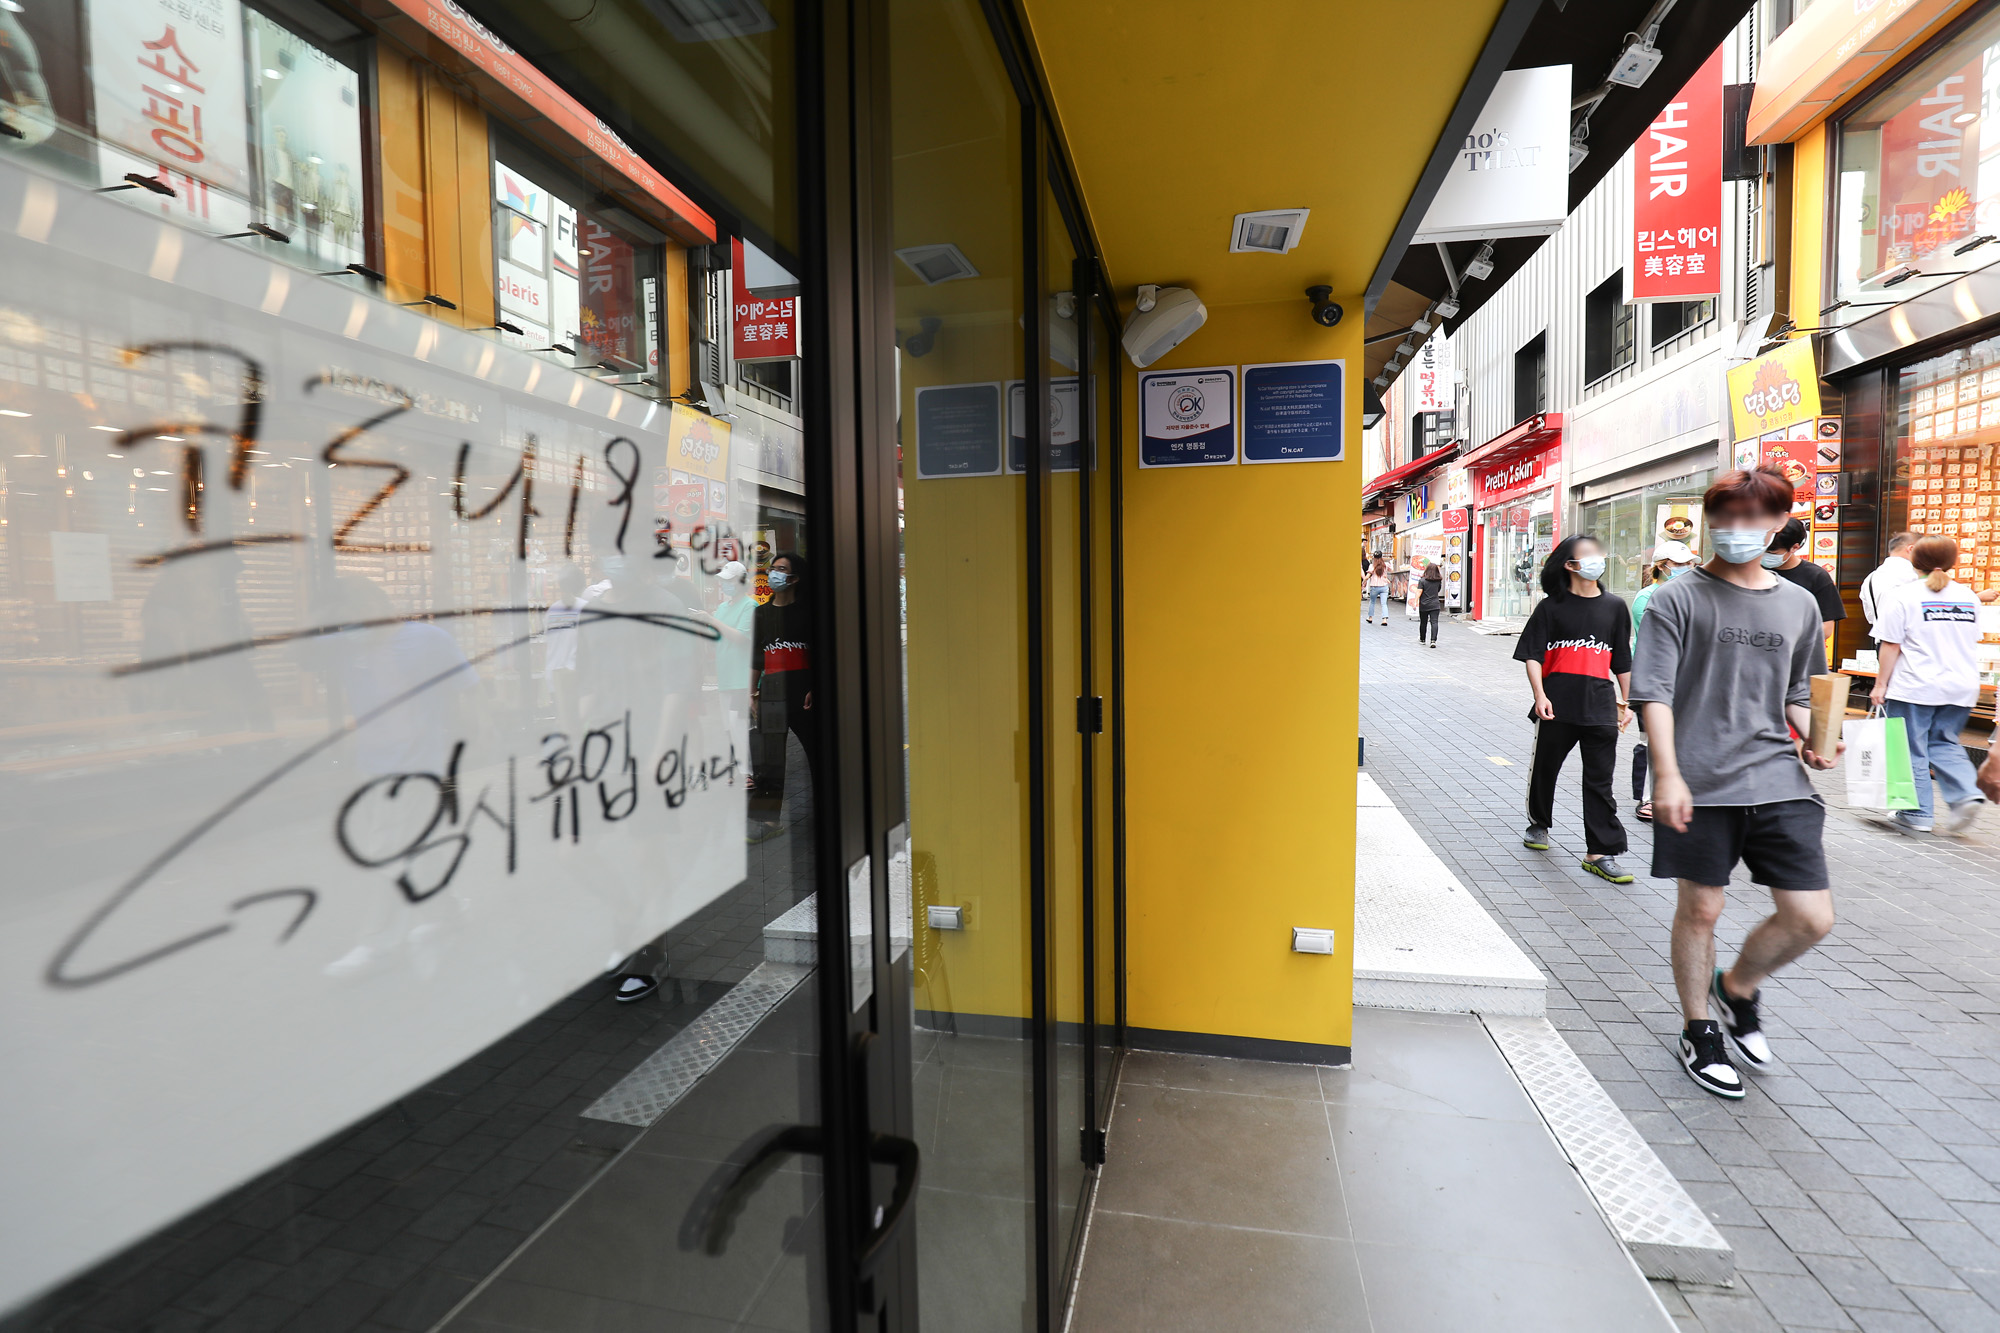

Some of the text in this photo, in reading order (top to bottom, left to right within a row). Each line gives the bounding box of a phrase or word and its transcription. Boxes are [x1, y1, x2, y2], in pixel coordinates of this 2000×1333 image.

[1464, 145, 1541, 172] THAT
[1650, 101, 1688, 201] HAIR
[1637, 226, 1717, 252] 킴스헤어
[1644, 253, 1705, 278] 美容室
[1743, 381, 1801, 418] 명화당
[1485, 457, 1533, 492] Pretty skin
[1405, 485, 1428, 524] Aha!
[1793, 490, 1815, 502] 국수
[1717, 626, 1784, 653] GREY
